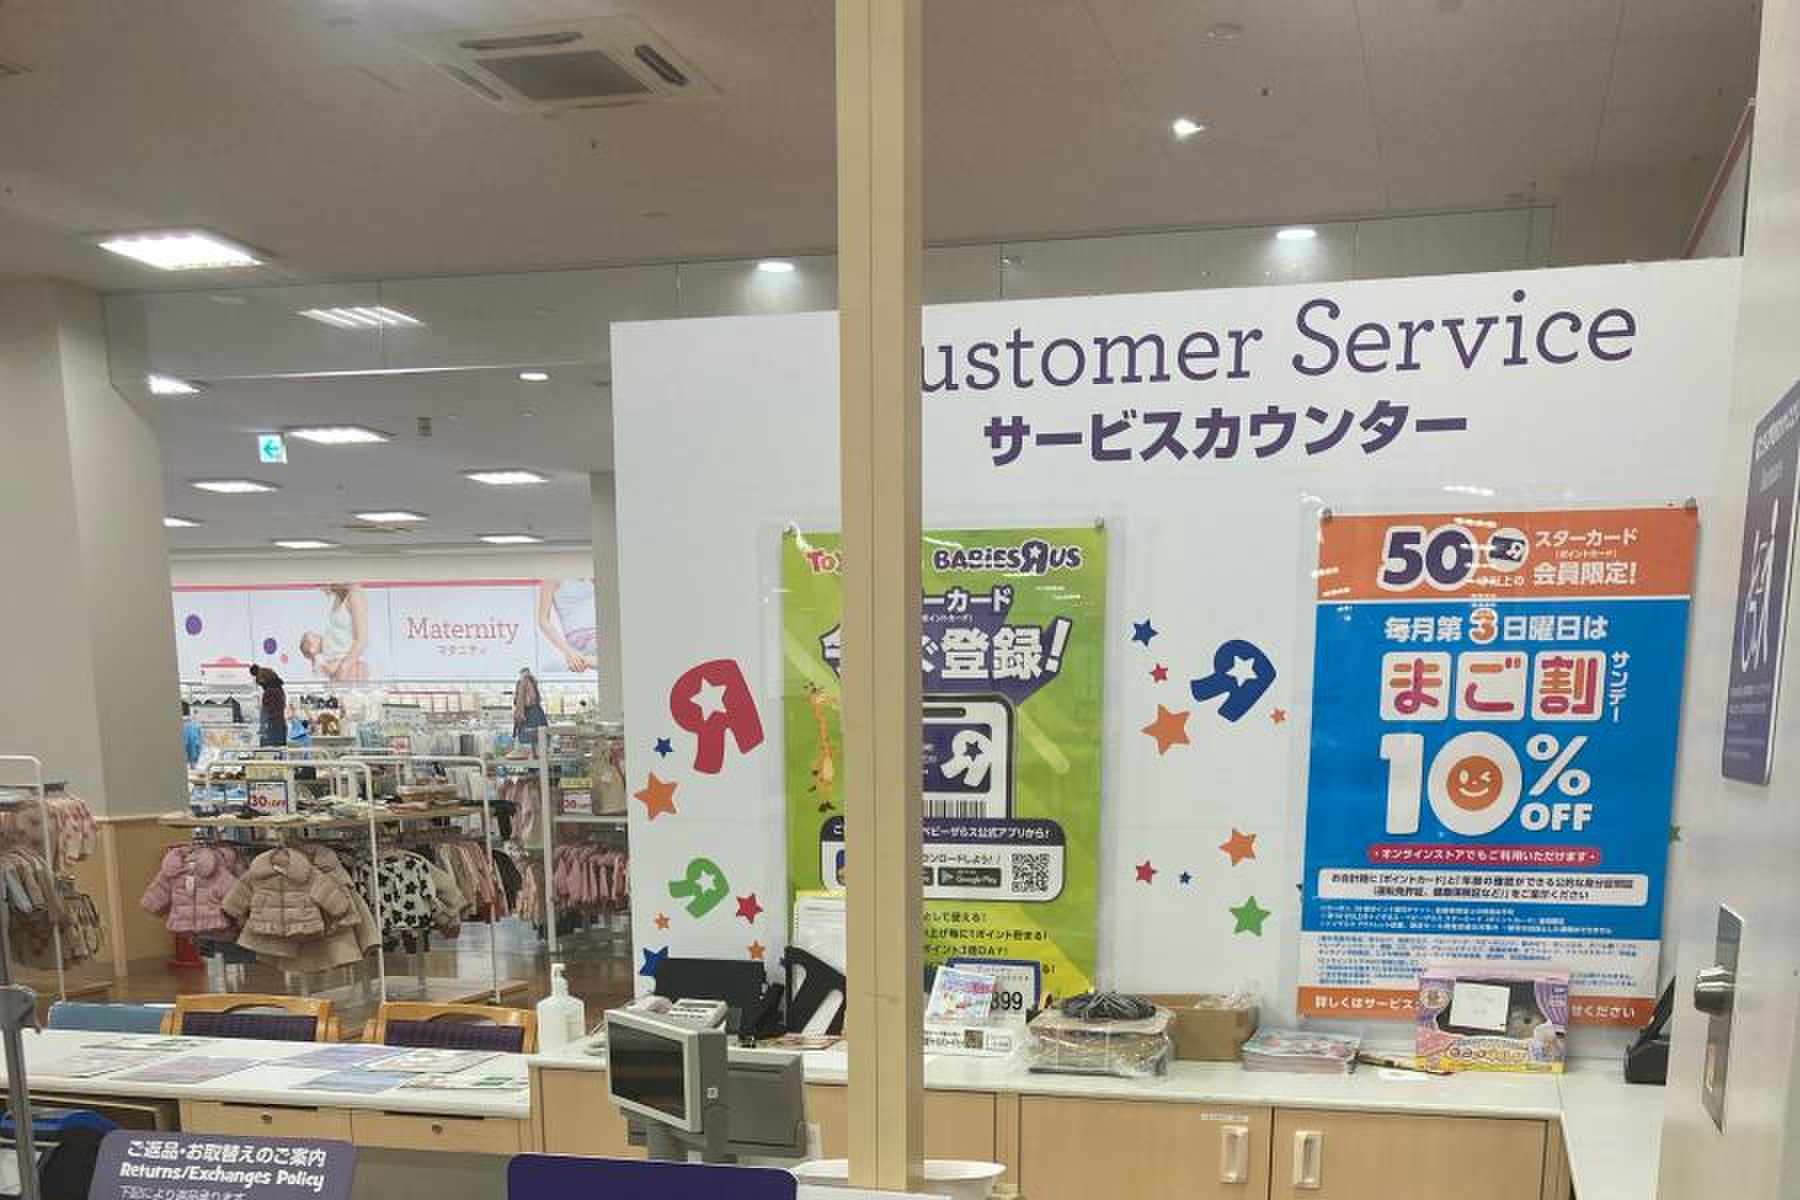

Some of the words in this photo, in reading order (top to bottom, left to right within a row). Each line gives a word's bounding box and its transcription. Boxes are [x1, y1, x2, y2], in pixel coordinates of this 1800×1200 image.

[921, 326, 1262, 392] ustomer
[1292, 289, 1637, 377] Service
[984, 399, 1467, 466] サービスカウンター
[1535, 527, 1639, 547] スターカード
[1533, 561, 1638, 586] 会員限定!
[923, 588, 1012, 613] ーカード
[406, 616, 519, 645] Maternity
[1387, 653, 1601, 717] まご割
[1611, 650, 1630, 723] サンデー
[1519, 802, 1594, 832] OFF
[127, 1139, 327, 1169] ご返品・お取替えのご案内
[119, 1161, 271, 1190] Returns/Exchanges
[276, 1169, 325, 1193] Policy
